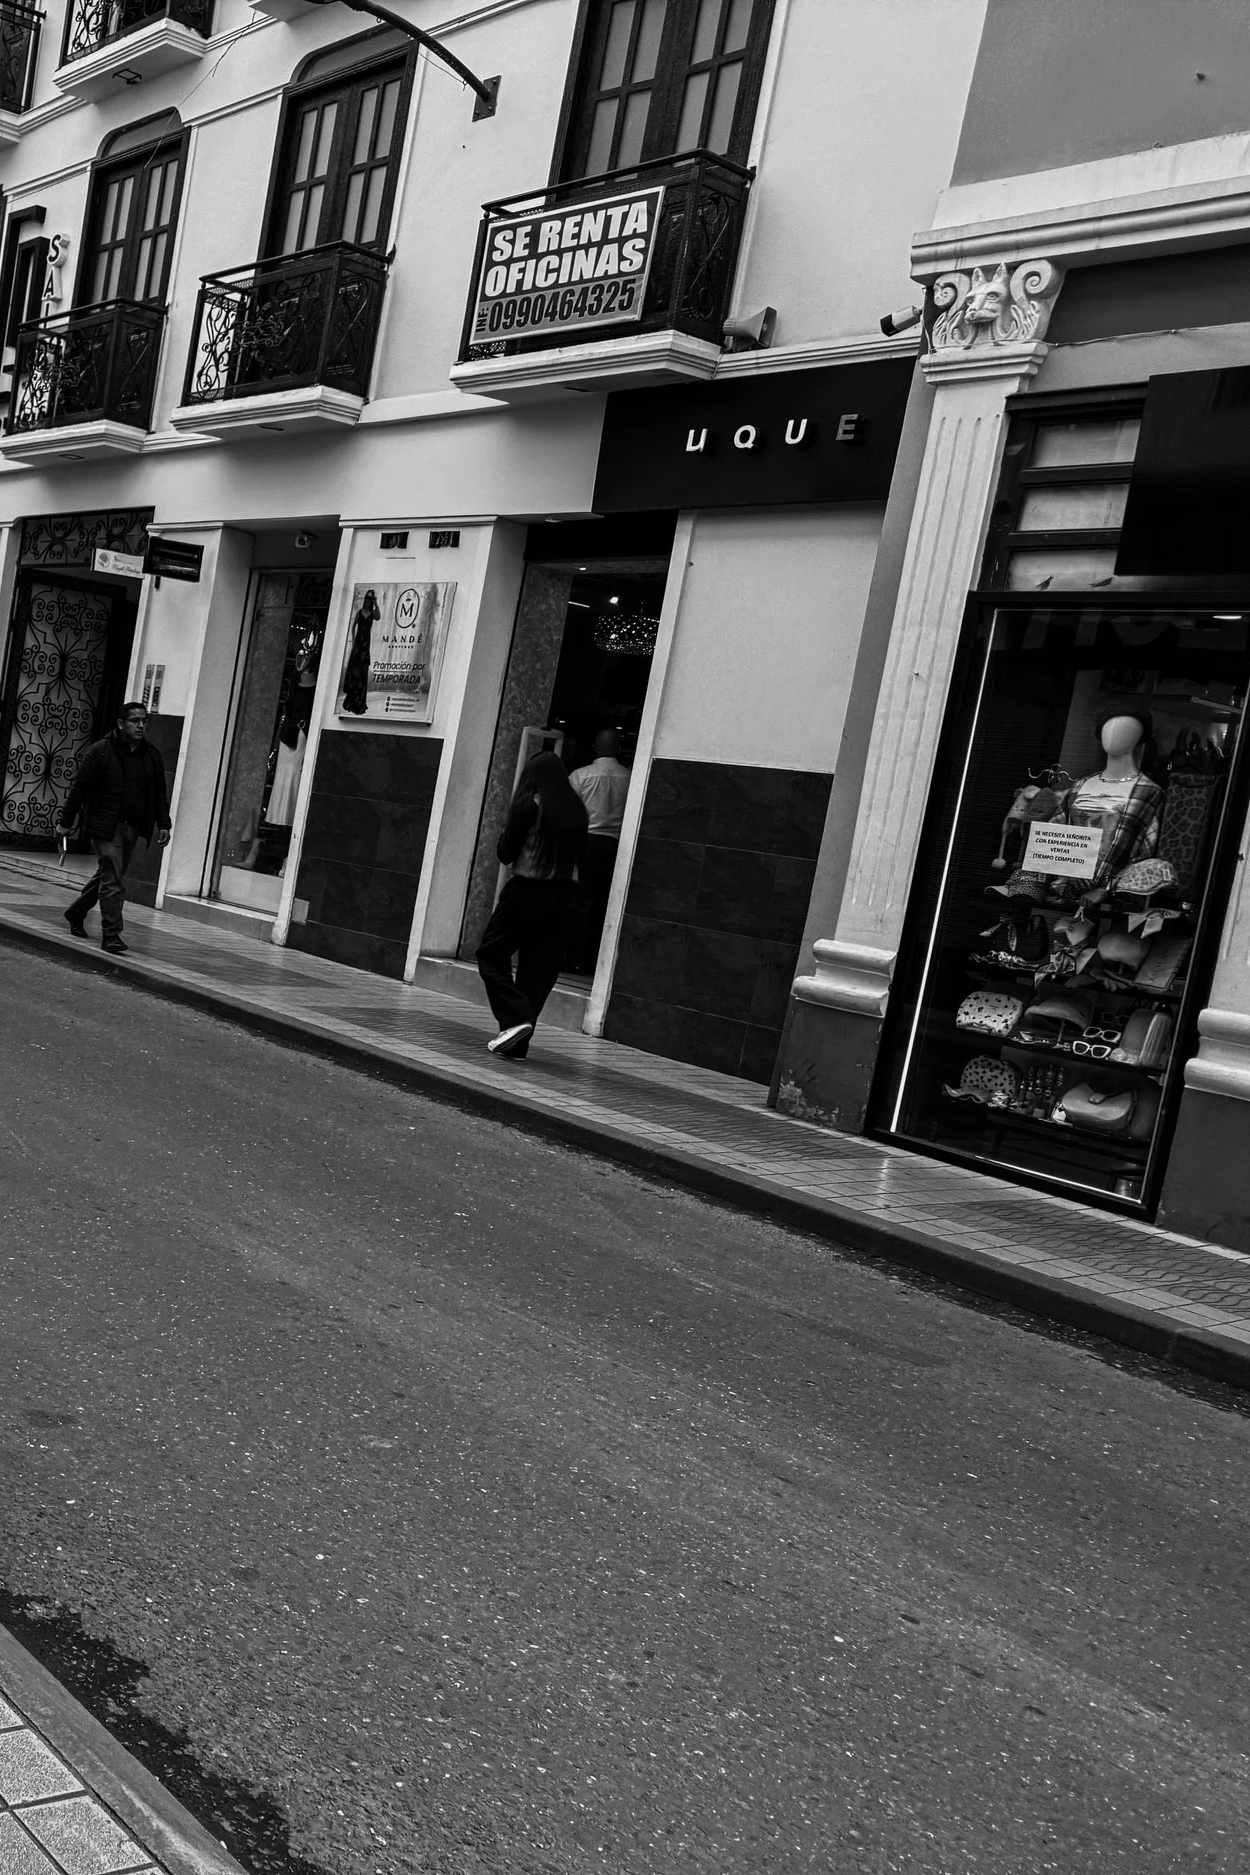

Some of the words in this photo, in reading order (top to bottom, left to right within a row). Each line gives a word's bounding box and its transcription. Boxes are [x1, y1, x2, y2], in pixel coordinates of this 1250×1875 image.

[491, 225, 533, 263] SE
[537, 200, 649, 254] RENTA
[484, 237, 647, 298] OFICINAS
[488, 278, 637, 333] 0990464325
[399, 602, 414, 618] M
[372, 660, 412, 671] Promoción
[411, 663, 426, 673] por
[372, 673, 421, 684] TEMPORADA
[1042, 831, 1065, 839] NECESITA
[1066, 833, 1092, 842] SEÑORITA
[1047, 839, 1080, 848] EXPERIENCIA
[1032, 853, 1054, 861] (TIEMPO
[1054, 855, 1085, 865] COMPLETO)
